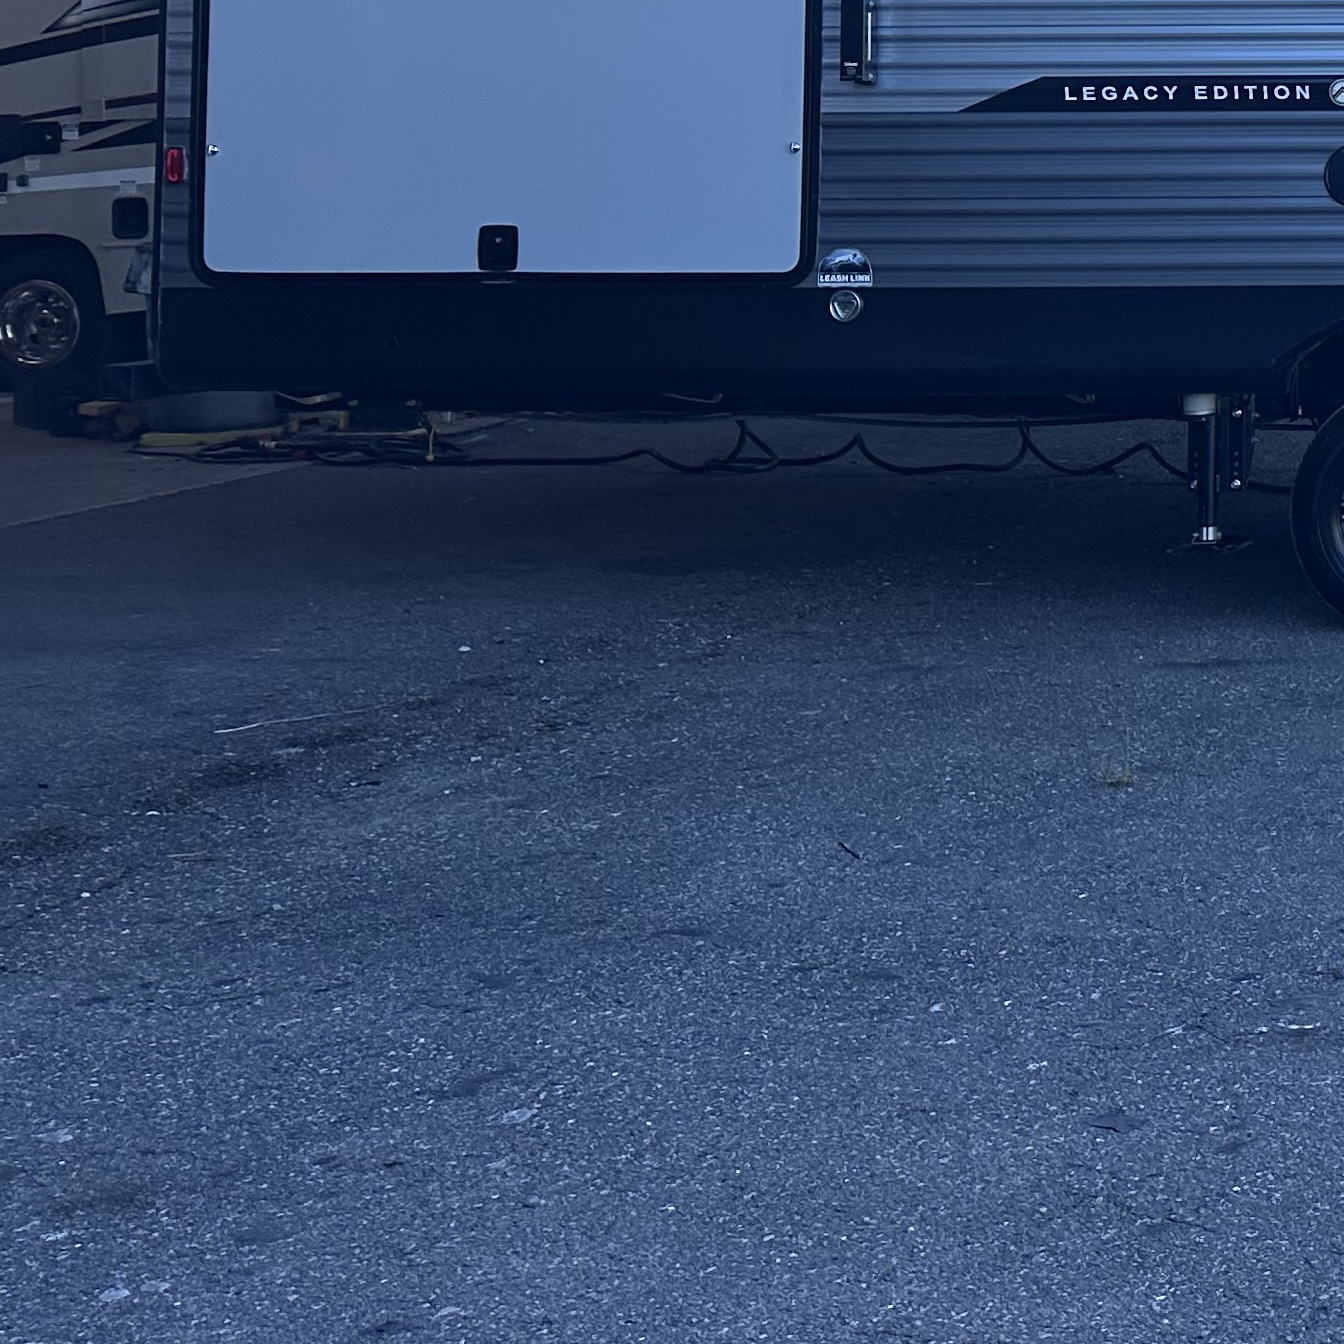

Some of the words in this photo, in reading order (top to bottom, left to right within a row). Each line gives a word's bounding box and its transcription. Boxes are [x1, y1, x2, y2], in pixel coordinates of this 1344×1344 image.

[1063, 84, 1179, 102] LEGACY
[1193, 84, 1312, 102] EDITION
[820, 274, 849, 283] LEASH
[850, 274, 871, 283] LINK
